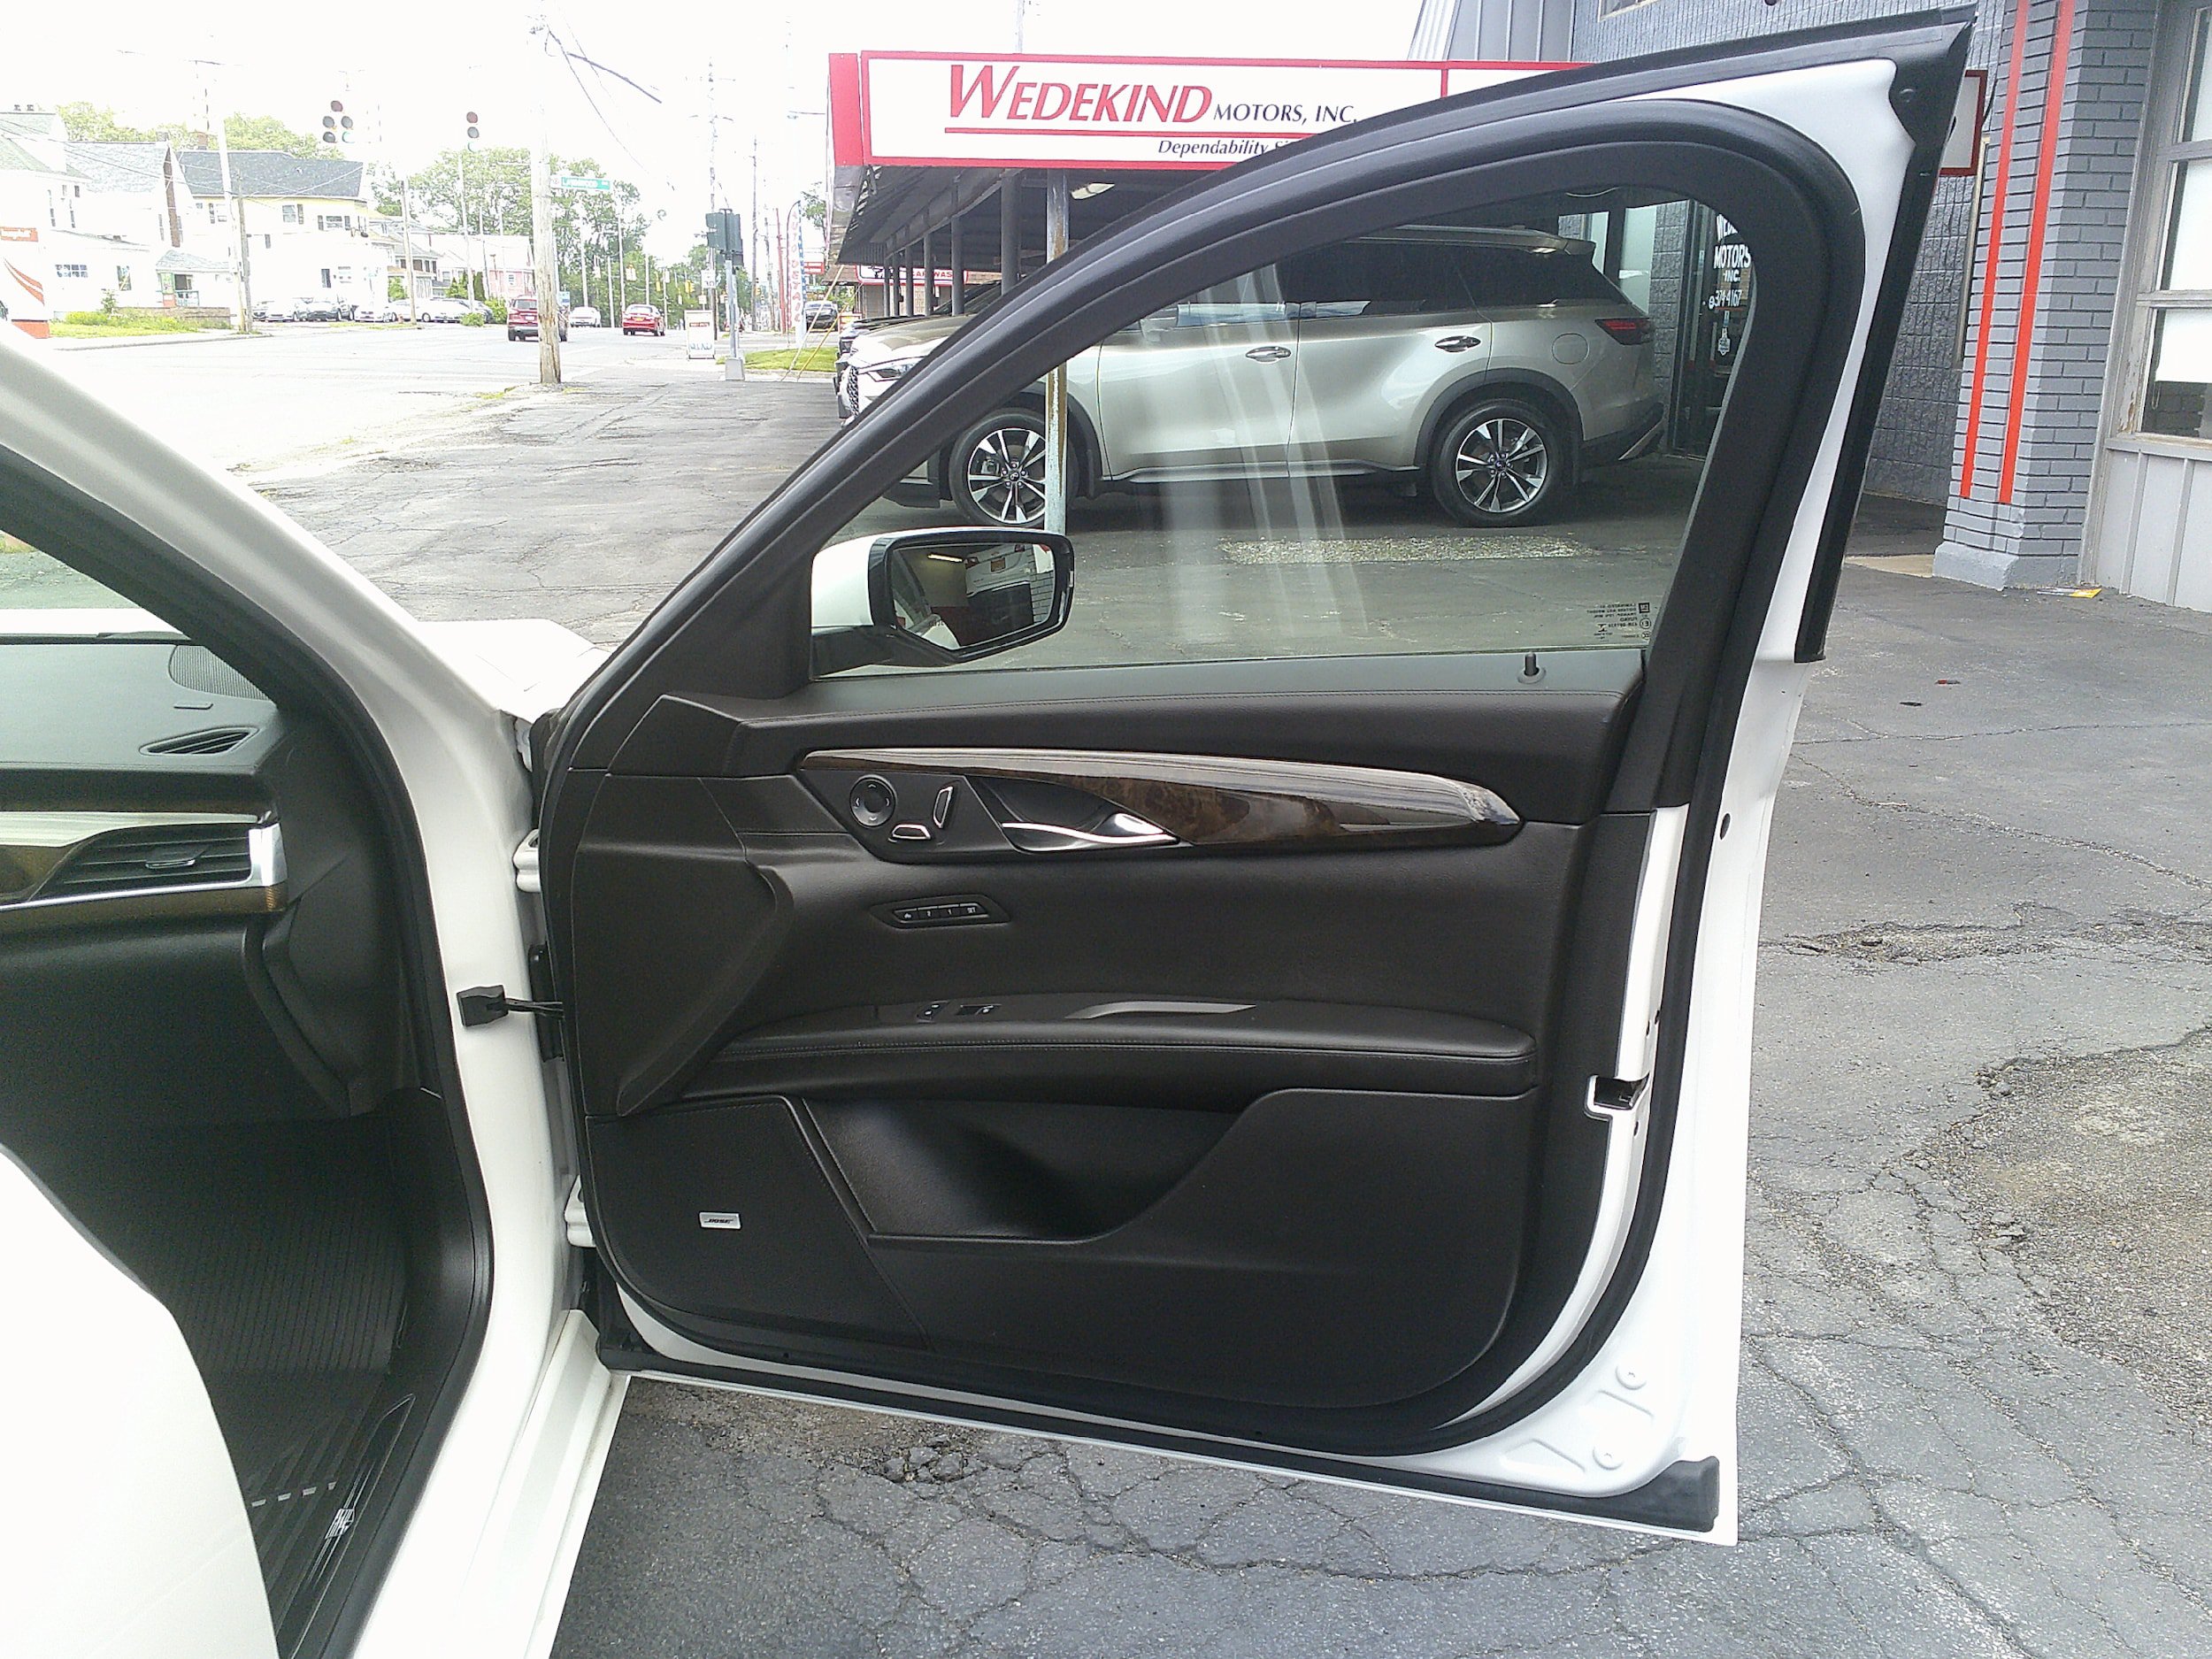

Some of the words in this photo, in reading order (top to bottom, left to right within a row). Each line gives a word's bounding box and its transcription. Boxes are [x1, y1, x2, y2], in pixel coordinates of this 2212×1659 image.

[950, 65, 1212, 123] WEDEKIND
[1214, 104, 1307, 126] MOTORS,
[1315, 104, 1357, 123] INC.
[1158, 140, 1269, 158] Dependability
[1713, 244, 1751, 268] MOTORS
